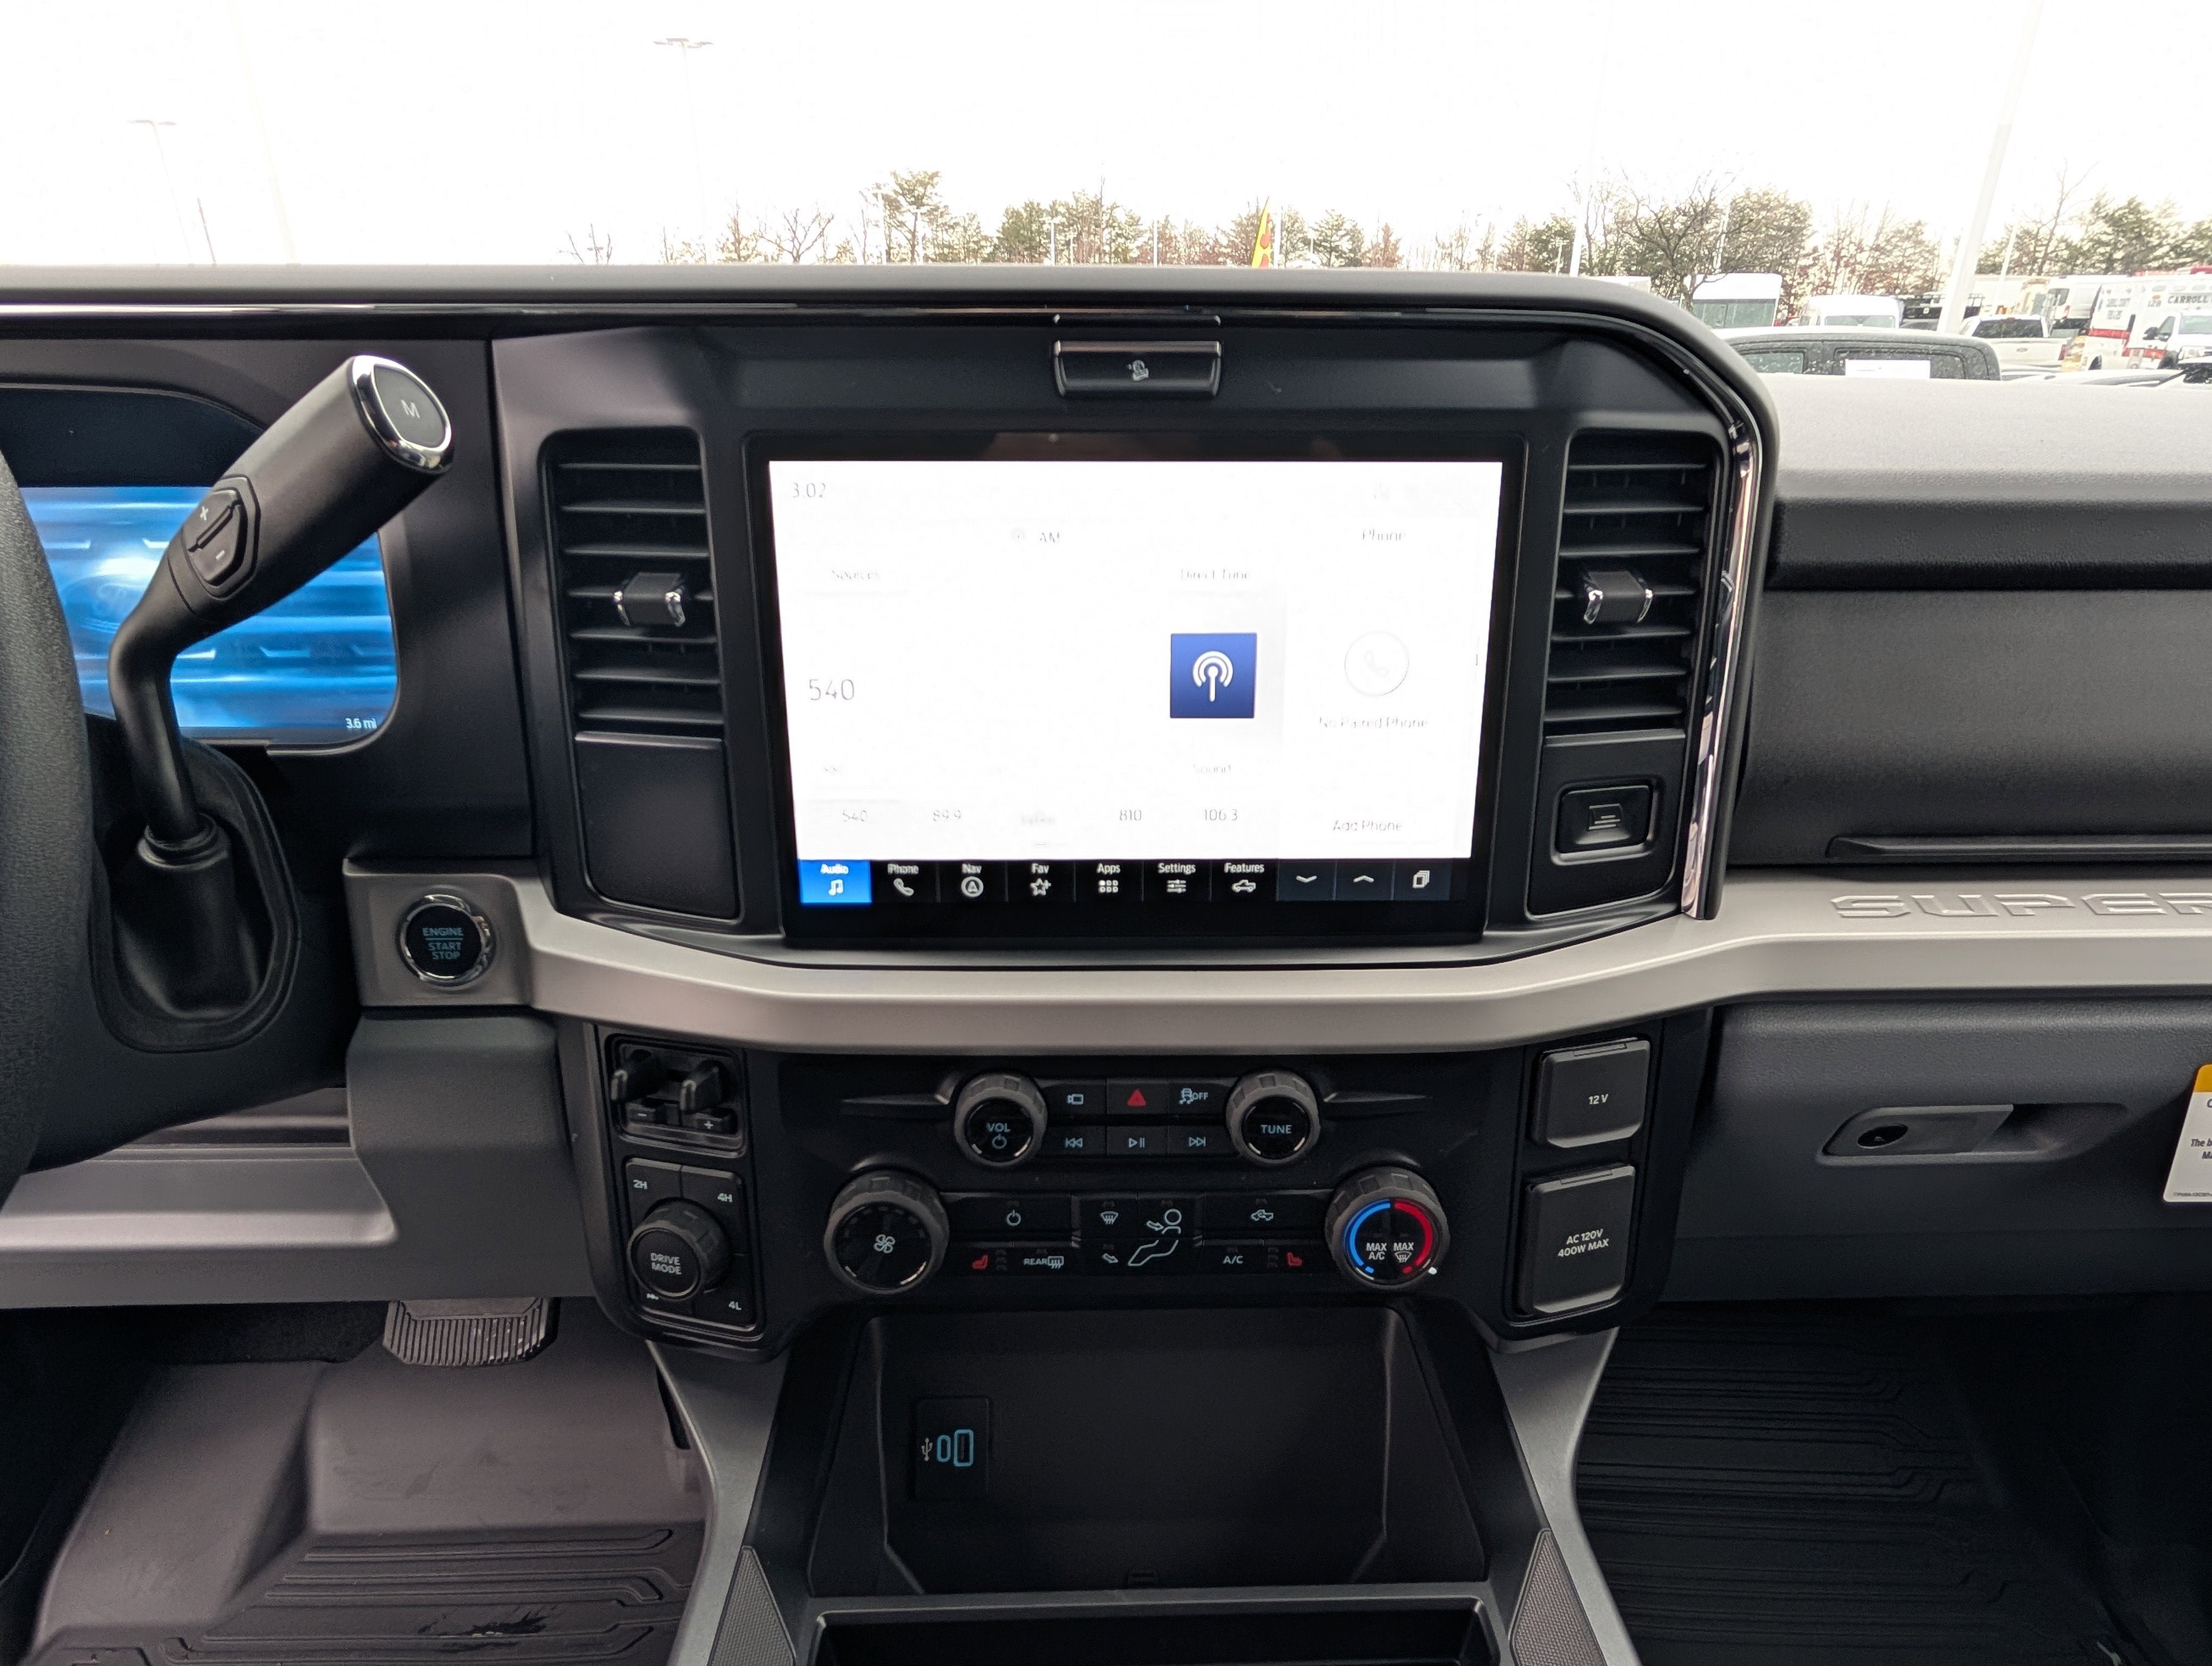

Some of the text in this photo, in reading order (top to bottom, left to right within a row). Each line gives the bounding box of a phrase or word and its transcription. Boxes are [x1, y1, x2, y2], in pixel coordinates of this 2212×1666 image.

[2168, 296, 2208, 304] CARROLL
[402, 400, 420, 419] M
[808, 679, 855, 701] 540
[345, 717, 377, 729] 3.6 mi
[1119, 809, 1142, 821] 810
[820, 863, 849, 875] Audio
[888, 863, 919, 874] Phone
[962, 863, 982, 874] Nav
[1032, 863, 1050, 874] Fav
[1097, 863, 1121, 874] Apps
[1158, 862, 1196, 875] Settings
[1224, 862, 1265, 873] Features
[422, 927, 464, 937] ENGINE
[428, 942, 461, 951] START
[432, 952, 461, 960] STOP
[1589, 1093, 1609, 1105] 12 V
[986, 1123, 1011, 1133] VOL
[1261, 1125, 1291, 1134] TUNE
[633, 1179, 648, 1189] 2H
[717, 1193, 732, 1203] 4H
[1566, 1228, 1604, 1245] AC 120V
[1366, 1242, 1387, 1252] MAX
[1393, 1242, 1414, 1251] MAX
[1558, 1238, 1610, 1258] 400W MAX
[651, 1252, 680, 1265] DRIVE
[1223, 1255, 1243, 1265] A/C
[1369, 1251, 1386, 1260] A/C
[651, 1262, 682, 1274] MODE
[728, 1301, 742, 1311] 4L
